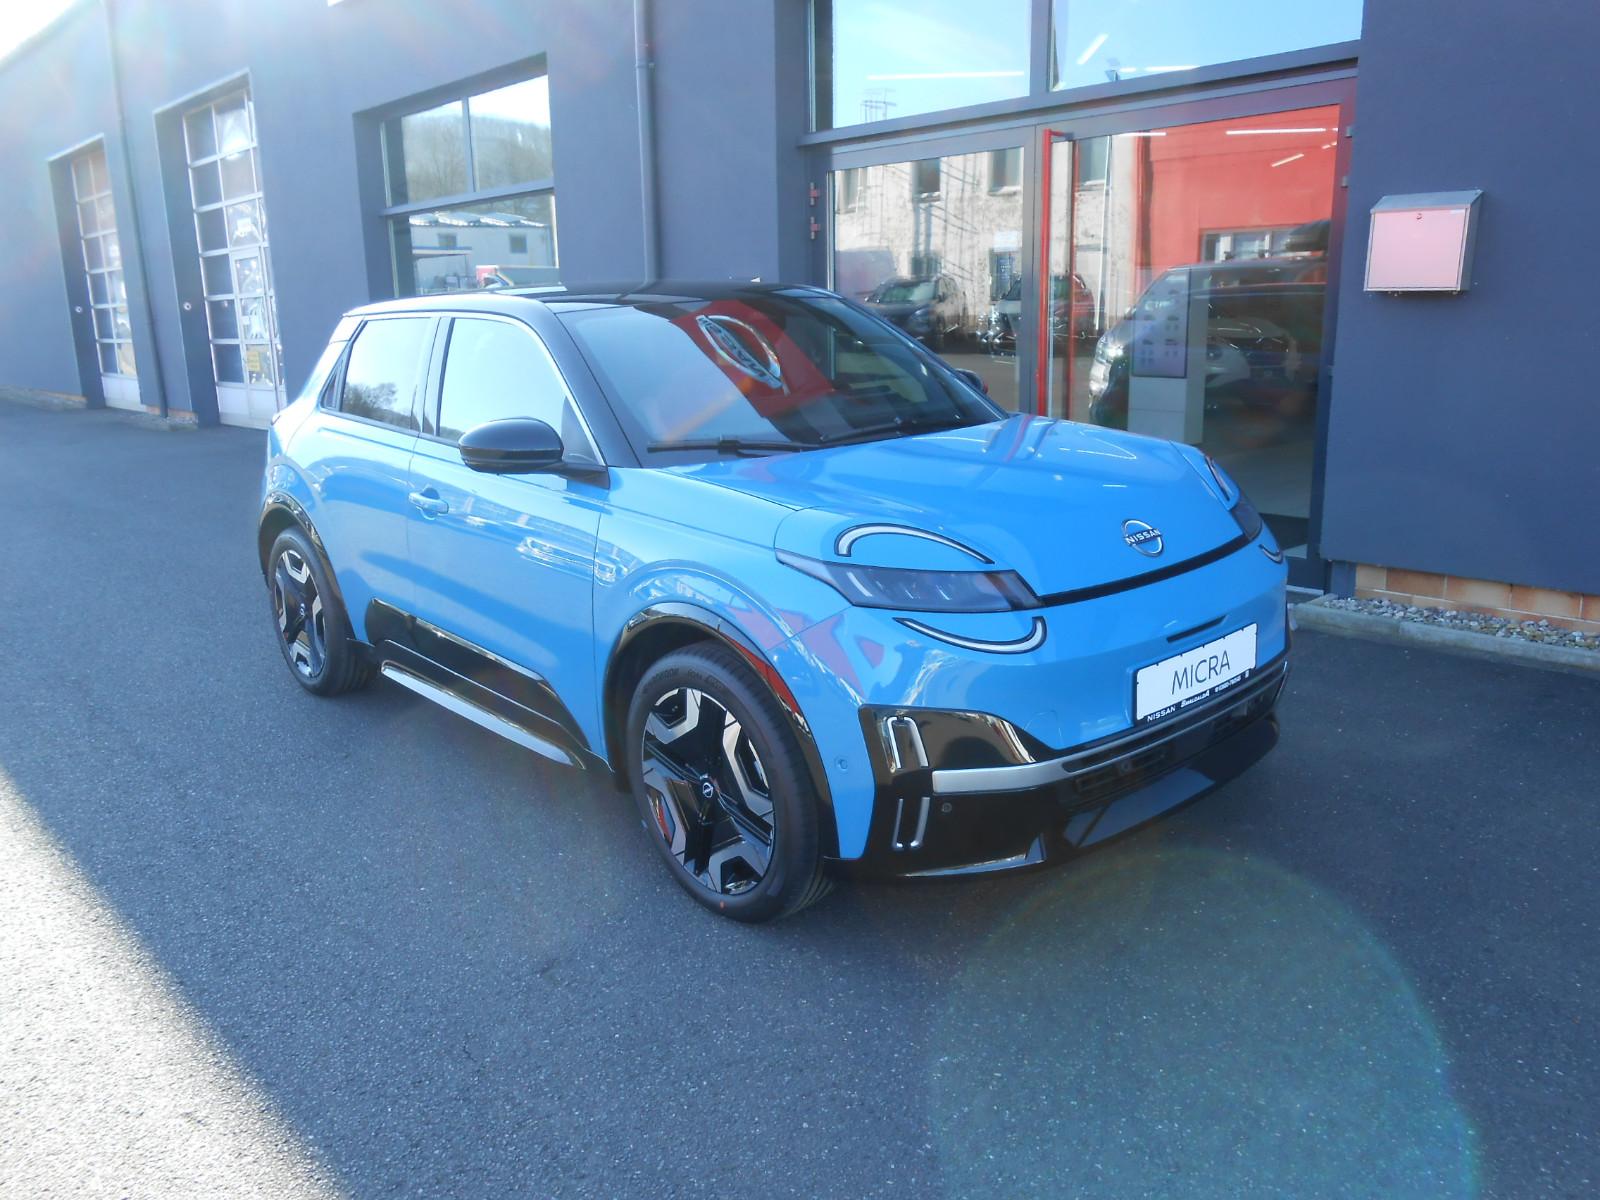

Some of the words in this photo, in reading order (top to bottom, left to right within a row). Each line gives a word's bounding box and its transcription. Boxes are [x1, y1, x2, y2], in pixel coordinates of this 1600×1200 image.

[1125, 528, 1162, 545] NISSAN
[1171, 651, 1230, 694] MICRA
[1147, 705, 1176, 722] NISSAN
